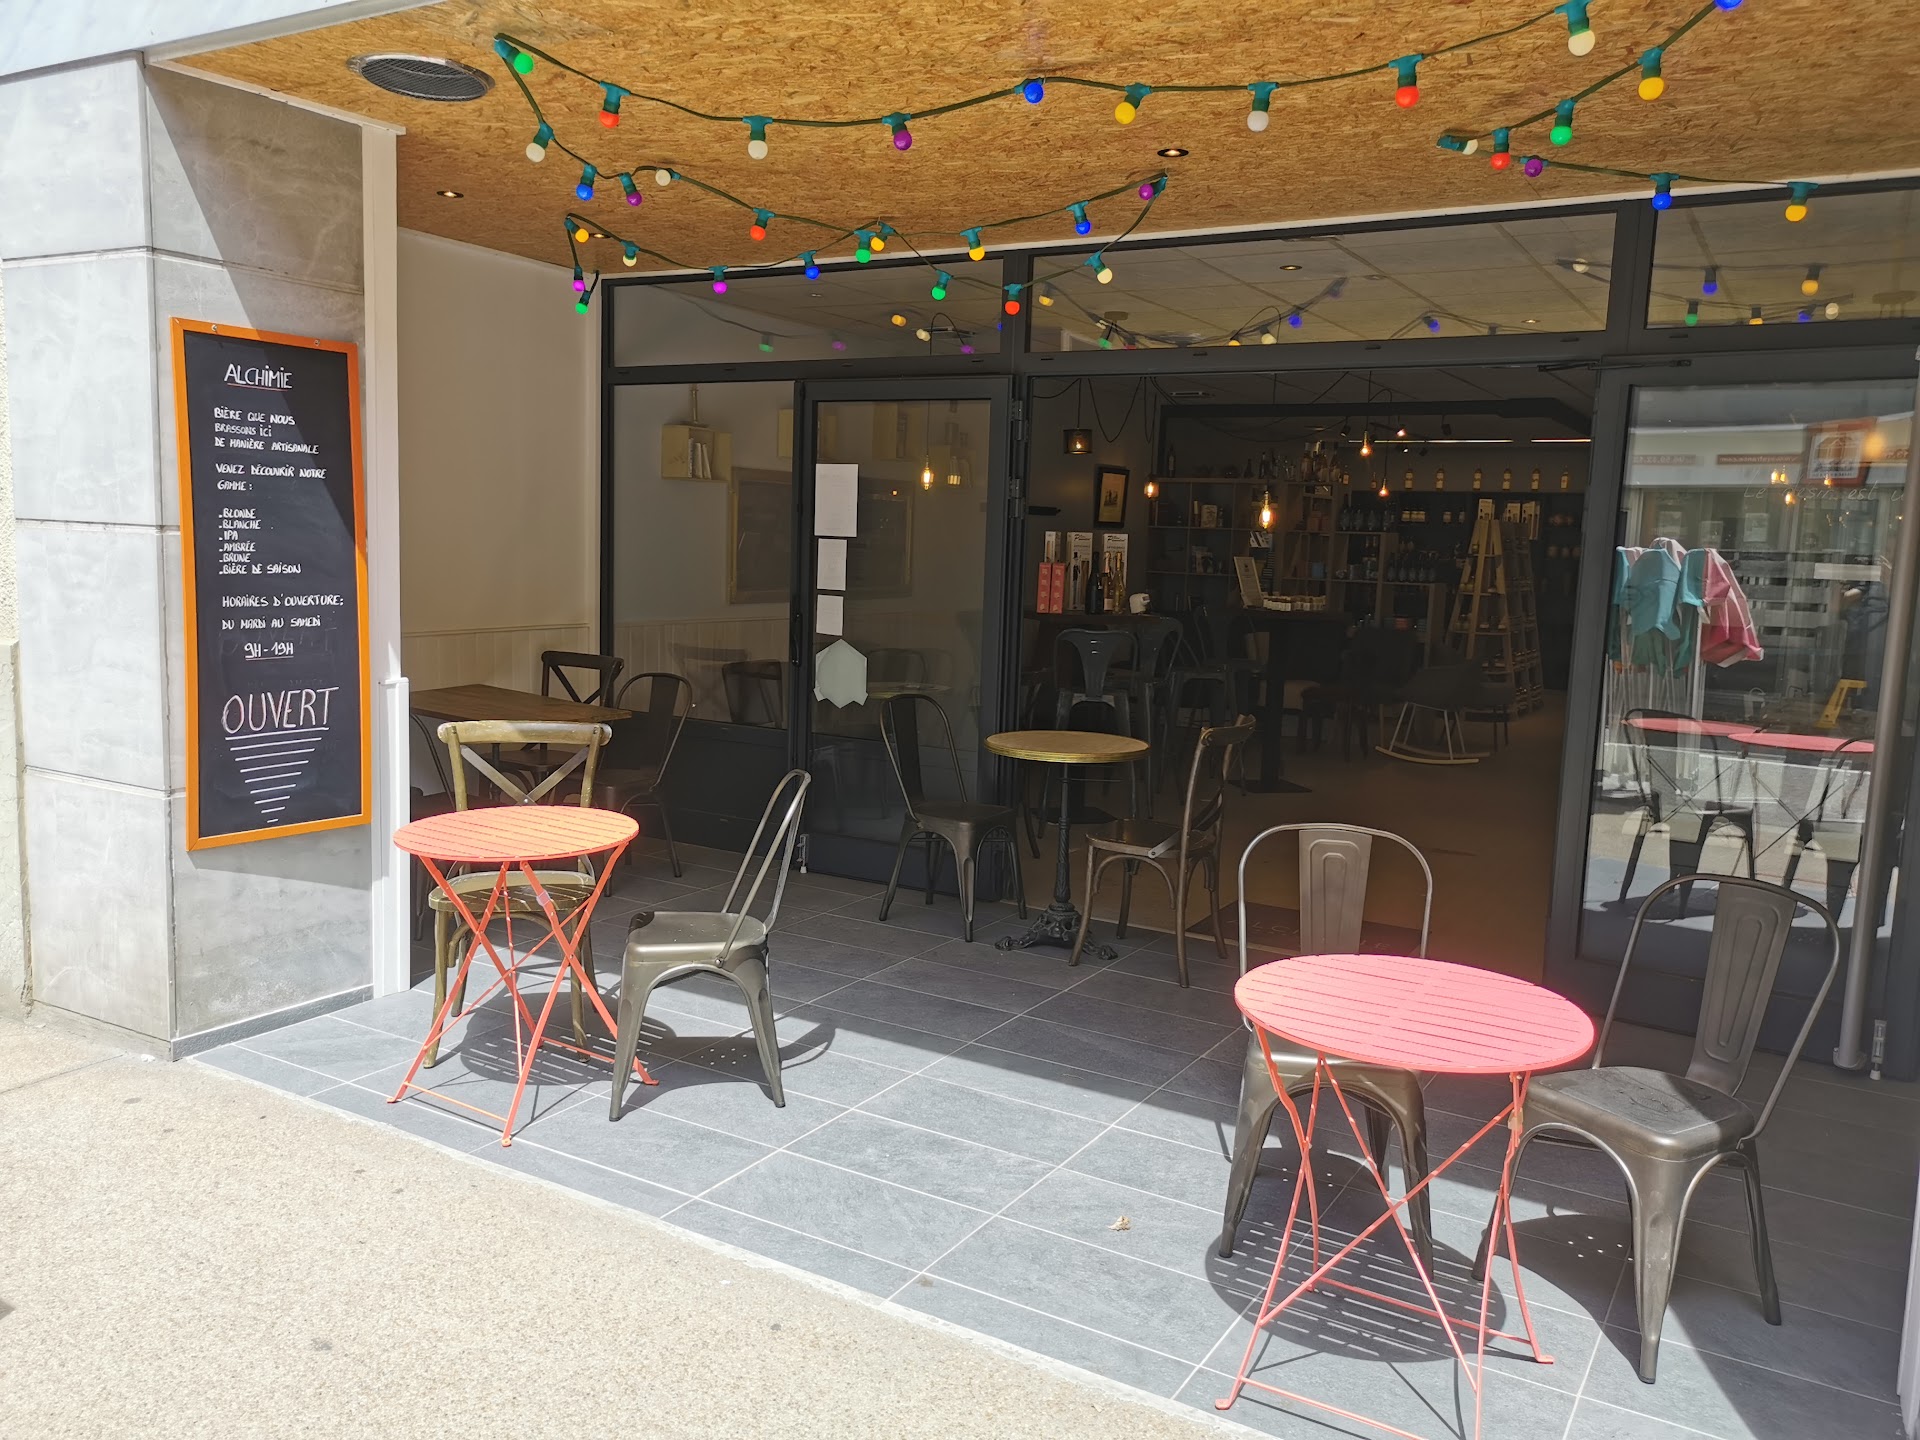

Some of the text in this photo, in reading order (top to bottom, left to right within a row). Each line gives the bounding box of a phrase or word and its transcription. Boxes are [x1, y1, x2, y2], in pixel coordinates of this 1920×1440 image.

[224, 363, 293, 389] ALCHIMIE
[214, 406, 296, 426] BIÈRE QUE NOUS
[214, 423, 256, 436] BRASSONS
[214, 437, 319, 455] DE MANIÈRE ARTISANALE
[215, 463, 327, 479] VENEZ DÉCOUVRIR NOTRE
[251, 563, 263, 574] DE
[266, 562, 301, 574] SAISON
[222, 594, 269, 608] HORAIRES
[221, 615, 321, 630] DU MARDI AU SAMEDI
[221, 686, 340, 734] OUVERT
